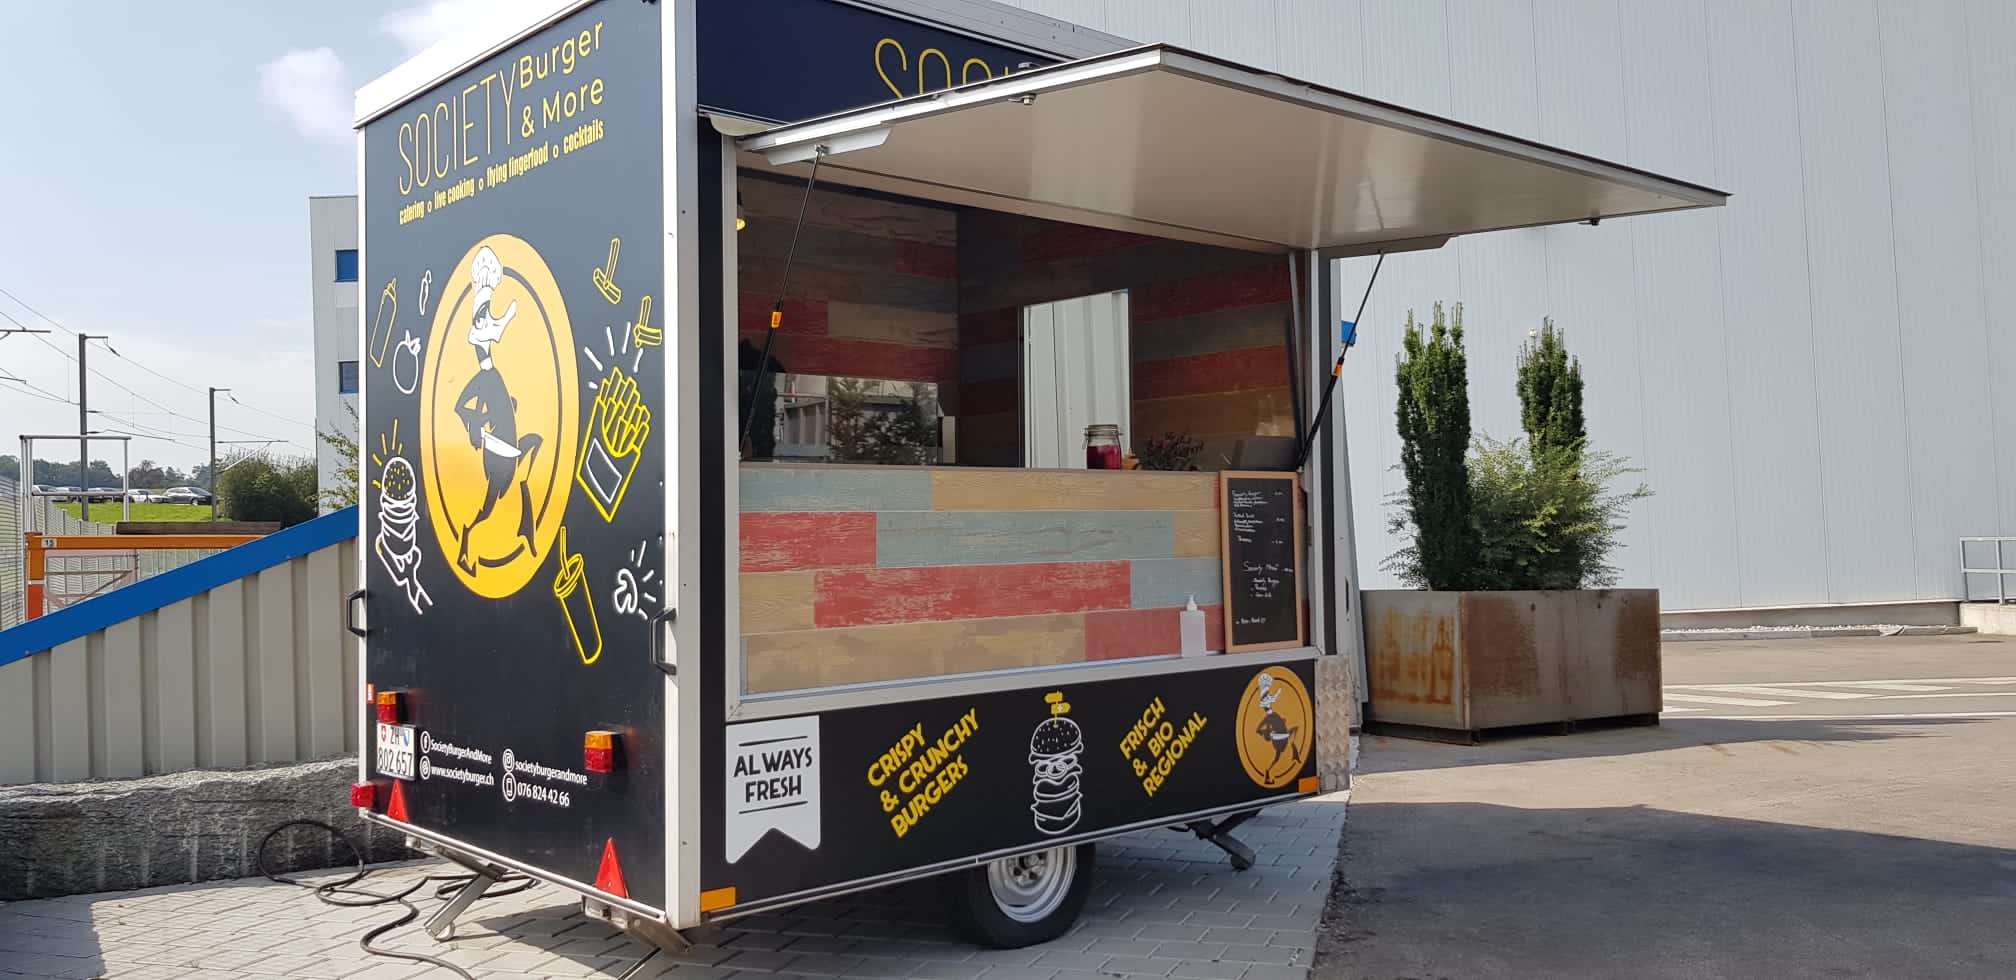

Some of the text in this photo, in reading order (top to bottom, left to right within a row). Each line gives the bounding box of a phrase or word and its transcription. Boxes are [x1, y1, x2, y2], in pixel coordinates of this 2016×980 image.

[398, 21, 603, 195] SOCIETY Burger
[521, 78, 604, 138] & More
[399, 200, 425, 225] catering
[434, 189, 447, 210] live
[447, 177, 475, 205] cooking
[486, 163, 507, 188] flying
[563, 118, 604, 155] cocktails
[390, 726, 400, 745] ZH
[430, 739, 493, 765] SocietyBurgerAndMore
[867, 721, 926, 787] CRISPY
[1120, 696, 1166, 760] FRISCH
[1132, 721, 1174, 777] & BIO
[1142, 711, 1208, 797] REGIONAL
[430, 765, 495, 787] www.societyburger.ch
[514, 759, 588, 785] societyburgerandmore
[733, 746, 813, 778] ALWAYS
[745, 774, 802, 803] FRESH
[880, 707, 979, 813] & CRUNCHY
[517, 782, 570, 808] 076 824 42 66
[890, 754, 969, 838] BURGERS
